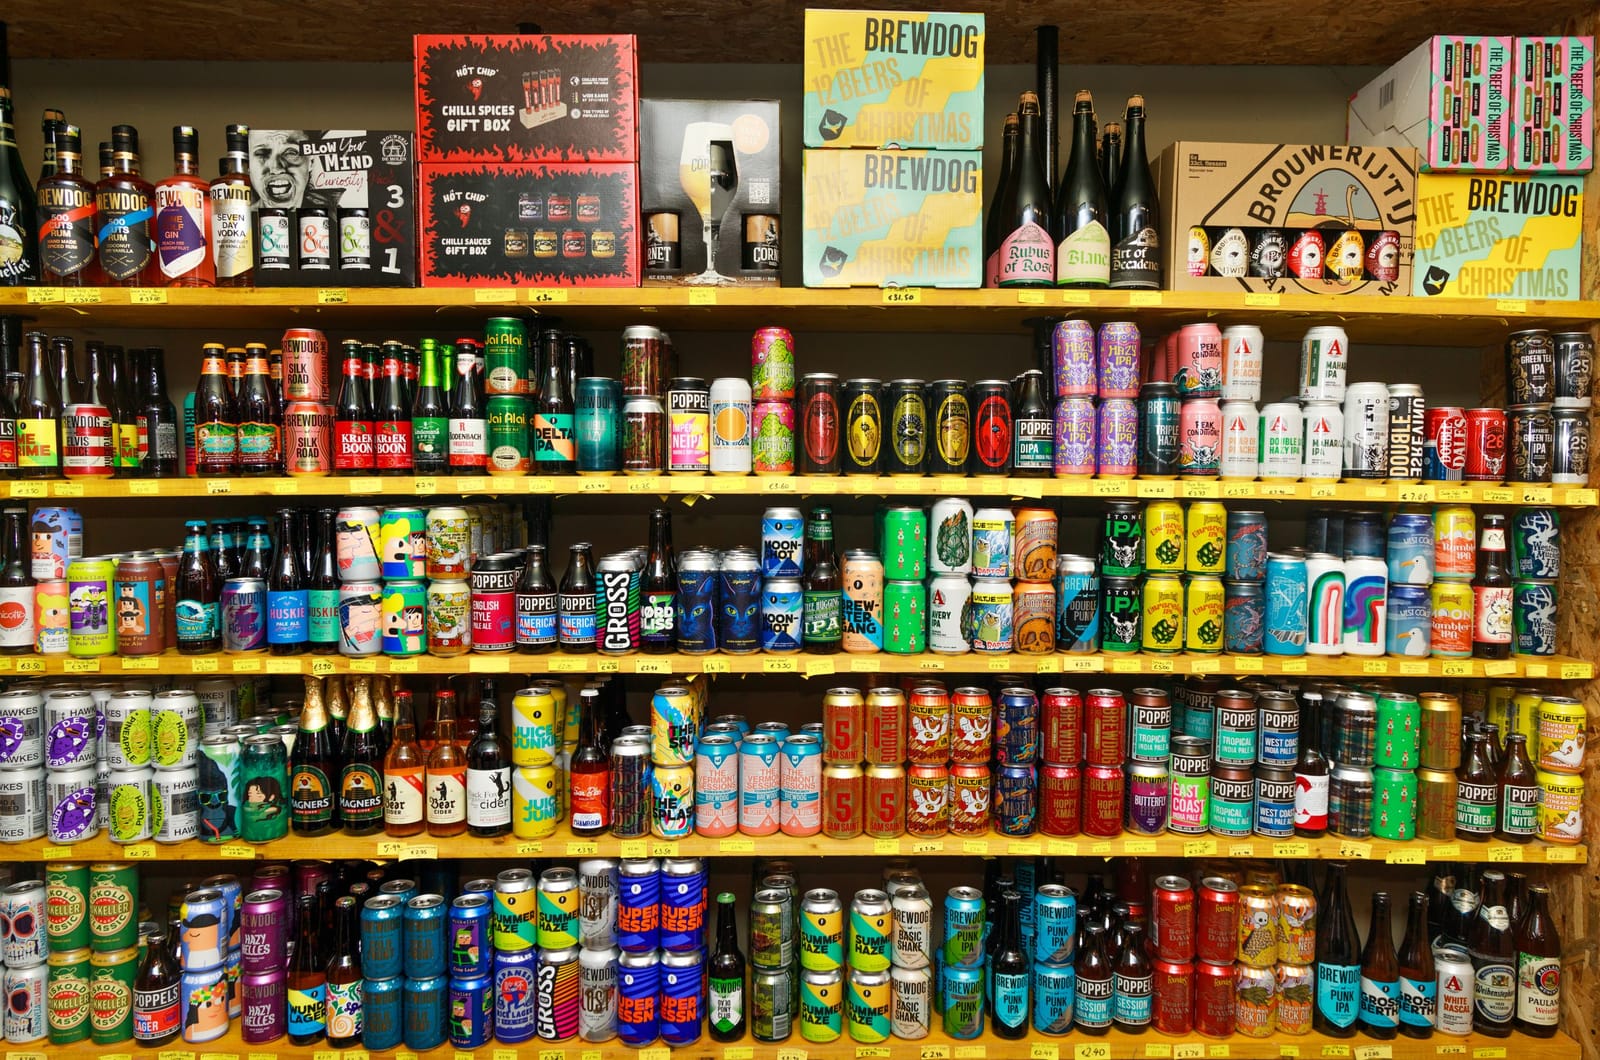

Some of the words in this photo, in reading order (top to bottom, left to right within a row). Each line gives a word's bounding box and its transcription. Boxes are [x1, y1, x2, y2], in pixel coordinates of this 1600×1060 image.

[865, 17, 978, 58] BREWDOG
[813, 32, 855, 69] THE
[1489, 46, 1503, 61] THE
[1571, 46, 1583, 62] THE
[477, 66, 496, 77] CHIP
[812, 74, 838, 107] 12
[836, 57, 904, 102] BEERS
[1488, 74, 1502, 100] BEERS
[1570, 73, 1583, 101] BEERS
[904, 77, 932, 108] OF
[442, 106, 476, 115] CHILLI
[478, 106, 515, 115] SPICES
[1488, 102, 1501, 112] OF
[1570, 103, 1582, 112] OF
[447, 119, 479, 132] GIFT
[484, 119, 510, 131] BOX
[855, 112, 971, 144] CHRISTMAS
[1487, 114, 1501, 161] CHRISTMAS
[1569, 113, 1582, 161] CHRISTMAS
[325, 154, 373, 172] MIND
[864, 154, 977, 193] BREWDOG
[315, 172, 364, 192] Curiosity
[386, 185, 404, 208] 3
[465, 192, 486, 202] CHIP
[1468, 178, 1578, 217] BREWDOG
[1419, 192, 1459, 227] THE
[1417, 232, 1441, 263] 12
[1440, 216, 1502, 258] BEERS
[445, 247, 467, 255] GIFT
[1504, 235, 1532, 265] OF
[382, 248, 401, 274] 1
[1458, 267, 1568, 297] CHRISTMAS
[1065, 342, 1092, 353] HAZY
[1073, 352, 1088, 362] IPA
[289, 364, 307, 373] SILK
[1325, 370, 1337, 378] IPA
[1531, 364, 1545, 374] IPA
[288, 374, 309, 384] ROAD
[505, 412, 526, 424] Alai
[536, 428, 574, 439] DELTA
[1156, 425, 1179, 436] TRIPLE
[298, 437, 317, 446] SILK
[536, 440, 554, 451] IPA
[1158, 436, 1177, 446] HAZY
[1390, 414, 1411, 477] DOUBLE
[297, 447, 319, 458] ROAD
[378, 443, 406, 453] BOON
[1020, 443, 1039, 453] DIPA
[1106, 521, 1141, 537] IPA
[1457, 552, 1471, 560] IPA
[473, 575, 513, 588] POPPELS
[473, 600, 499, 611] ENGLISH
[604, 572, 630, 649] GROSS
[1070, 600, 1096, 611] DOUBLE
[1106, 597, 1140, 613] IPA
[270, 608, 305, 619] HUSKIE
[473, 612, 491, 622] STYLE
[932, 611, 951, 620] AVERY
[1074, 610, 1094, 621] PUNK
[842, 623, 876, 634] GANG
[932, 620, 941, 628] IPA
[1441, 630, 1458, 639] IPA
[1543, 713, 1571, 722] UILTJE
[177, 722, 185, 752] PUNCH
[513, 726, 553, 737] JUICE
[835, 720, 850, 750] 5
[881, 706, 898, 762] BREWDOG
[1059, 706, 1076, 762] BREWDOG
[1102, 707, 1118, 764] BREWDOG
[122, 716, 138, 762] PINEAPPLE
[1139, 734, 1167, 742] TROPICAL
[1223, 736, 1251, 745] TROPICAL
[1173, 784, 1200, 798] EAST
[429, 798, 456, 809] Bear
[480, 798, 509, 810] cider
[1053, 800, 1077, 809] HOPPY
[1135, 796, 1166, 806] BUTTERFLY
[1173, 798, 1206, 812] COAST
[136, 796, 145, 826] PUNCH
[1054, 810, 1075, 818] XMAS
[1457, 813, 1492, 826] WITBIER
[661, 903, 702, 918] SUPER
[539, 923, 568, 933] HAZE
[661, 918, 703, 932] SESSN
[899, 931, 921, 942] BASIC
[957, 931, 979, 941] PUNK
[1047, 926, 1068, 936] PUNK
[244, 934, 266, 944] HAZY
[1052, 937, 1065, 947] IPA
[898, 942, 922, 952] SHAKE
[961, 942, 974, 952] IPA
[134, 987, 178, 1007] POPPELS
[537, 964, 556, 1039] GROSS
[1004, 995, 1022, 1004] PUNK
[1330, 990, 1354, 1002] PUNK
[1444, 995, 1467, 1005] WHITE
[1008, 1004, 1019, 1014] IPA
[1117, 998, 1148, 1009] SESSION
[1336, 1002, 1350, 1013] IPA
[1444, 1005, 1470, 1013] RASCAL
[248, 1005, 271, 1015] HAZY
[245, 1015, 275, 1026] HELLES
